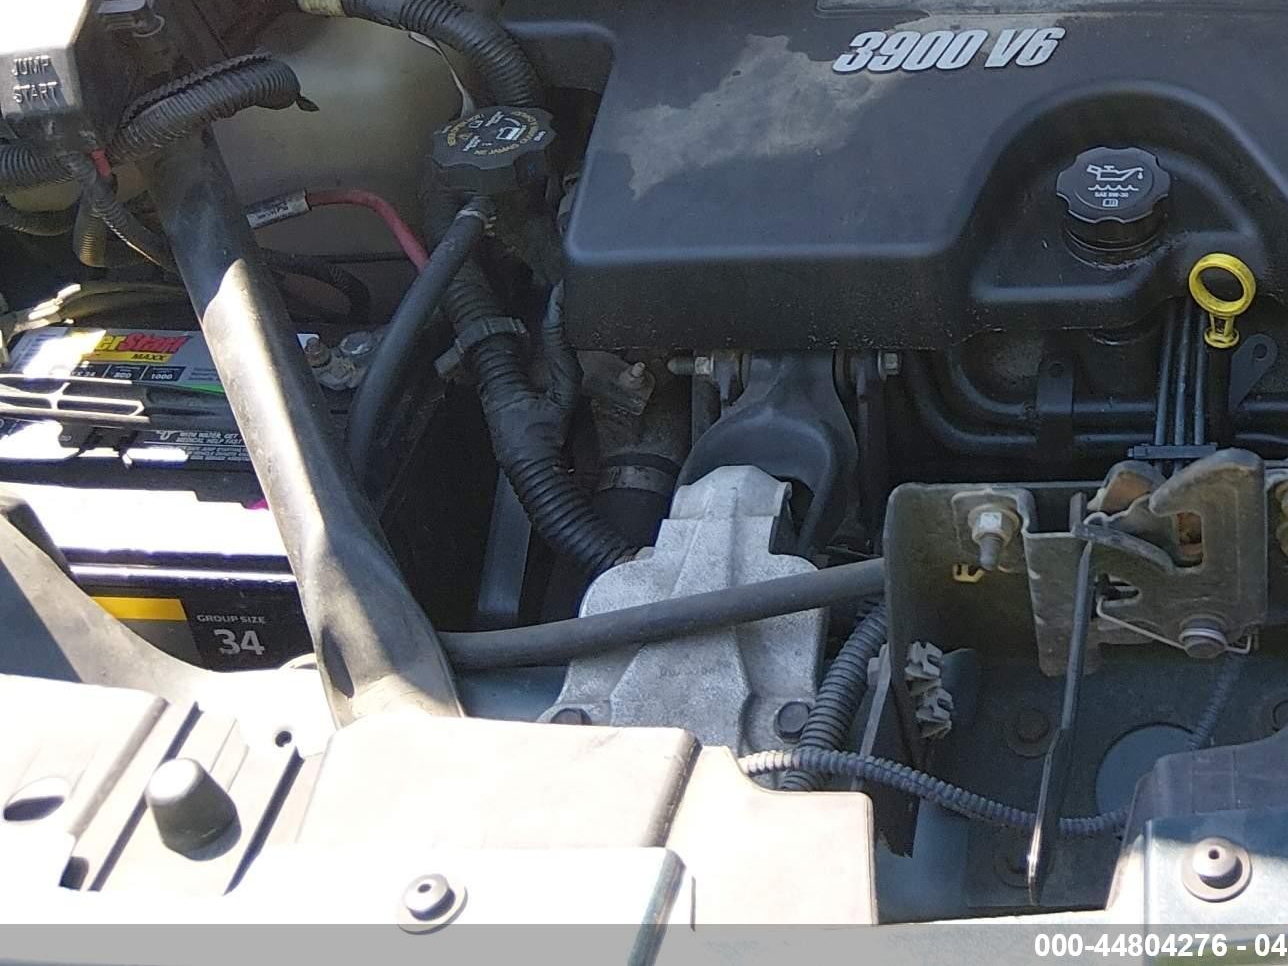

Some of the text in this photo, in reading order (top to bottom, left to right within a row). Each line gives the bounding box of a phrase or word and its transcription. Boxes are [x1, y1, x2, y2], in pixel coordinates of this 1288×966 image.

[832, 27, 1066, 73] 3900 V6
[11, 55, 50, 75] JUMP
[12, 81, 60, 109] START
[131, 353, 165, 361] MAXX
[196, 614, 266, 624] GROUP SIZE
[213, 628, 265, 655] 34
